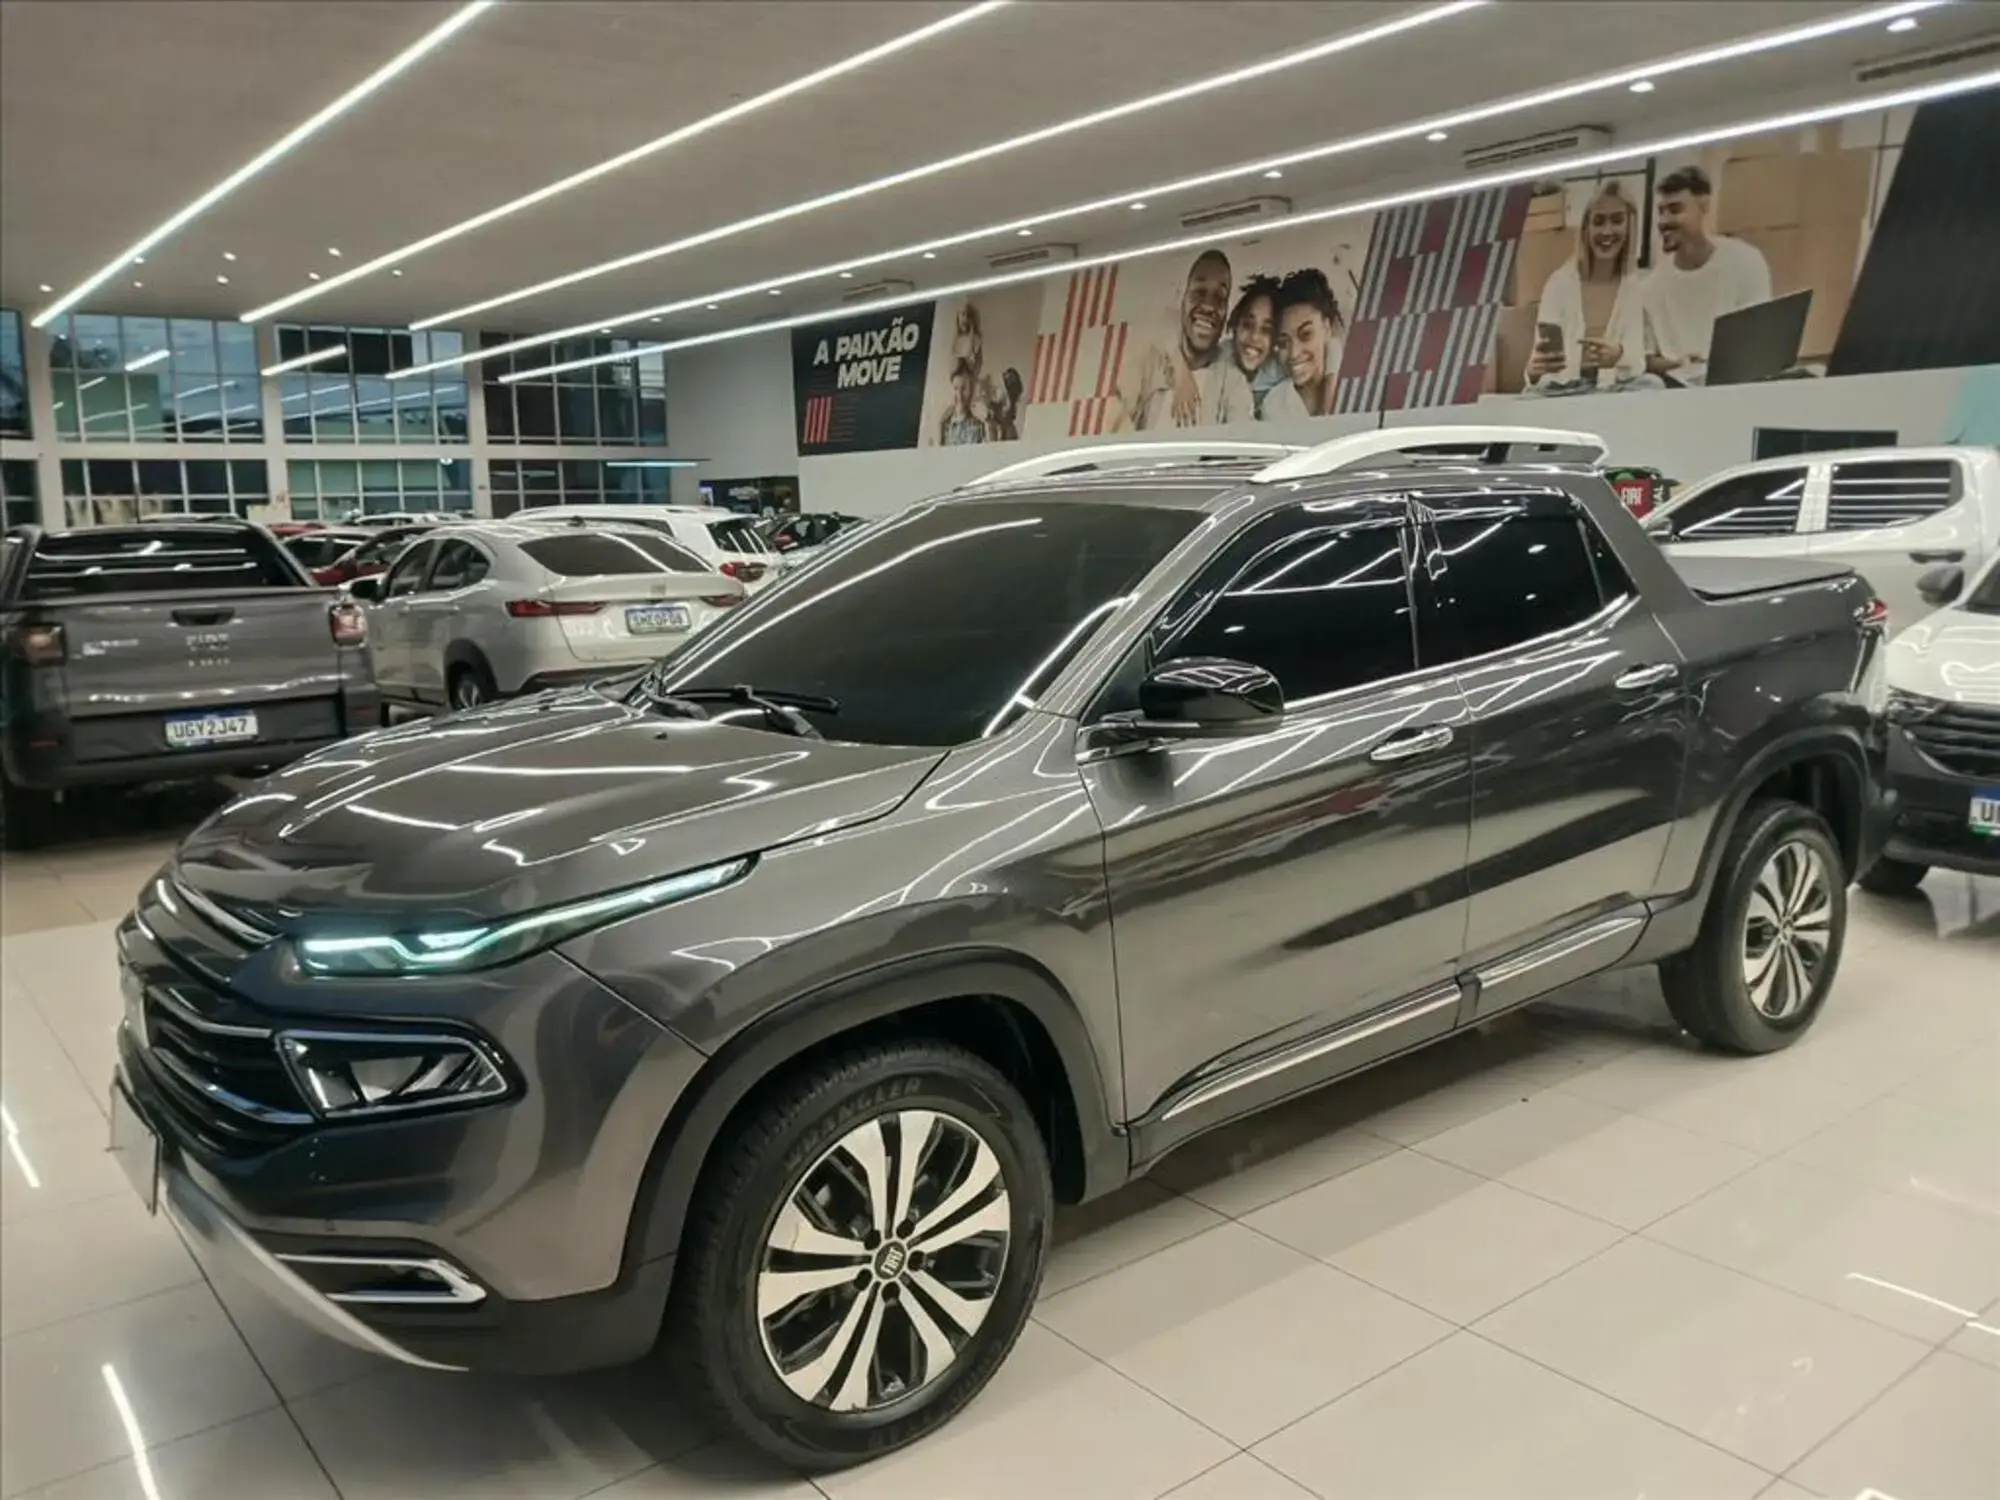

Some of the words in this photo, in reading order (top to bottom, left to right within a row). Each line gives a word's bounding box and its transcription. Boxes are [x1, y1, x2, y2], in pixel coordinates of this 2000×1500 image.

[813, 339, 829, 366] A
[834, 316, 920, 363] PAIXÃO
[837, 355, 902, 389] MOVE
